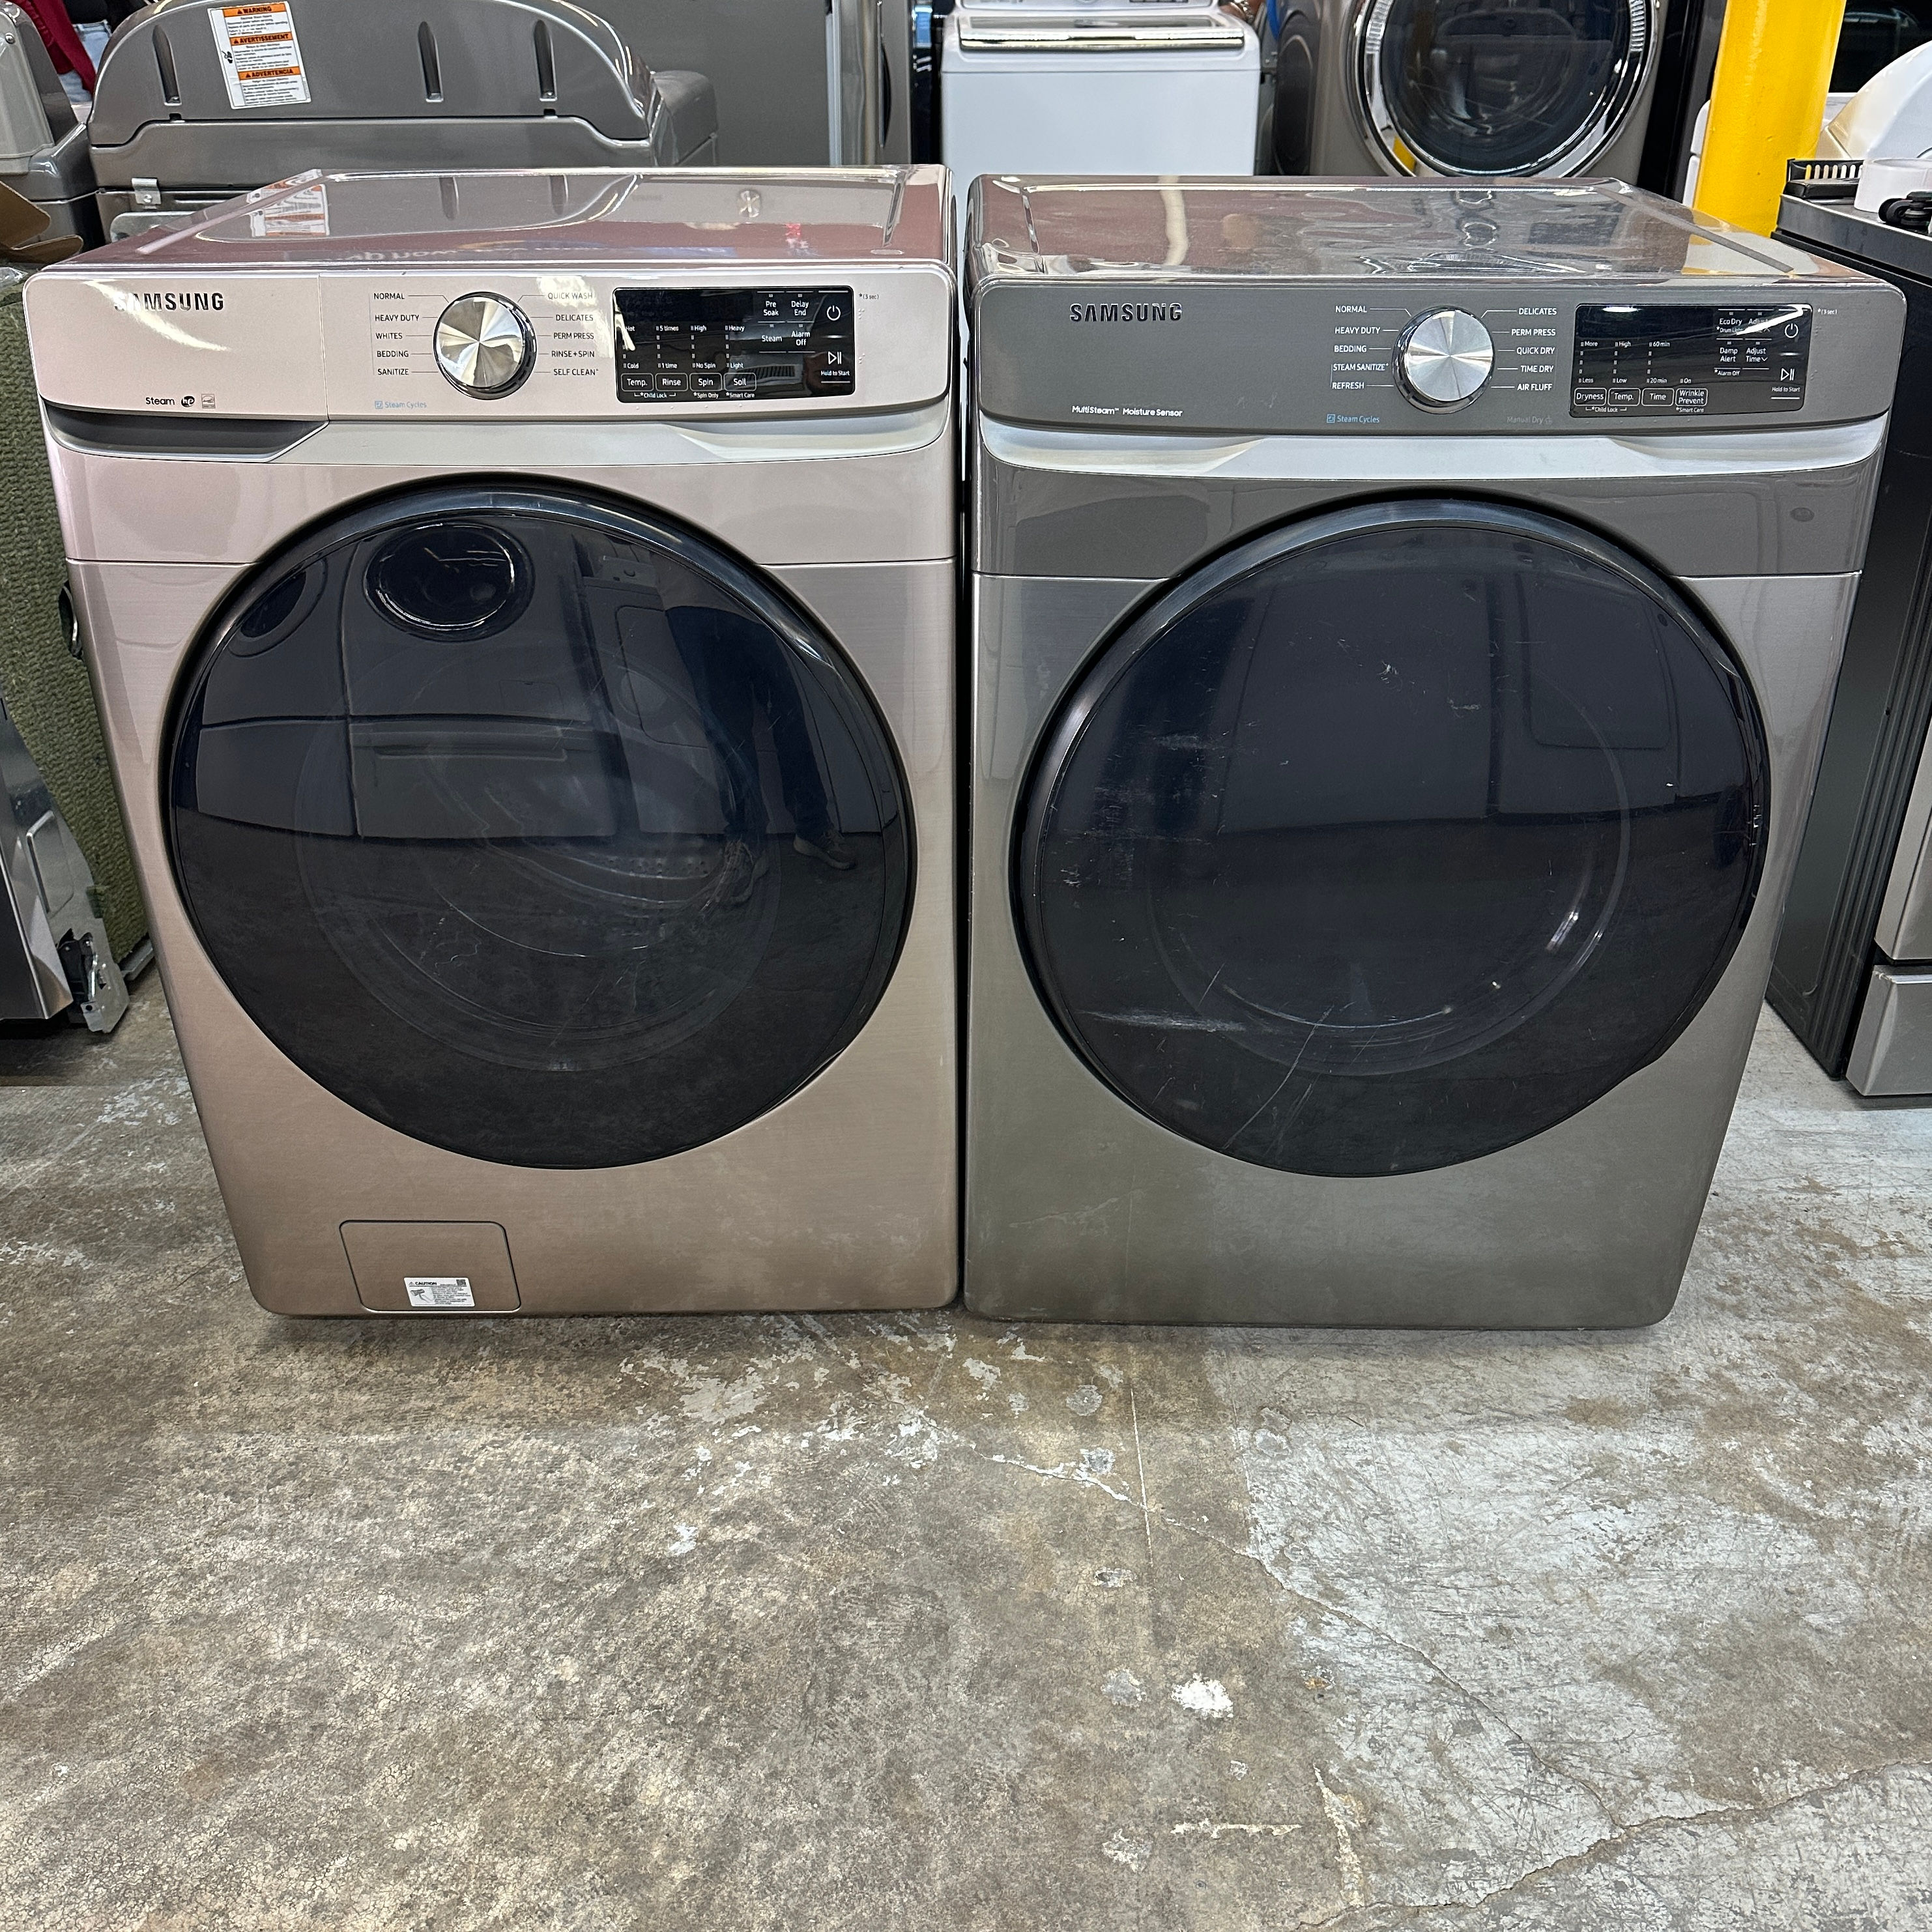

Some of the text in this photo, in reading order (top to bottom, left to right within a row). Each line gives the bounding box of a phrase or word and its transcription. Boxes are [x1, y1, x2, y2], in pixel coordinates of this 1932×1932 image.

[240, 33, 289, 44] AVERTISSEMENT
[252, 68, 293, 78] ADVERTENCIA
[1070, 303, 1182, 322] SAMSUNG
[698, 378, 714, 387] Spin
[1576, 392, 1604, 401] Dryness
[1615, 392, 1634, 401] Temp.
[145, 397, 175, 406] Steam
[1123, 407, 1155, 416] Moisture
[1156, 409, 1183, 417] Sensor
[1359, 415, 1379, 424] Cycles
[1531, 416, 1543, 424] Dry
